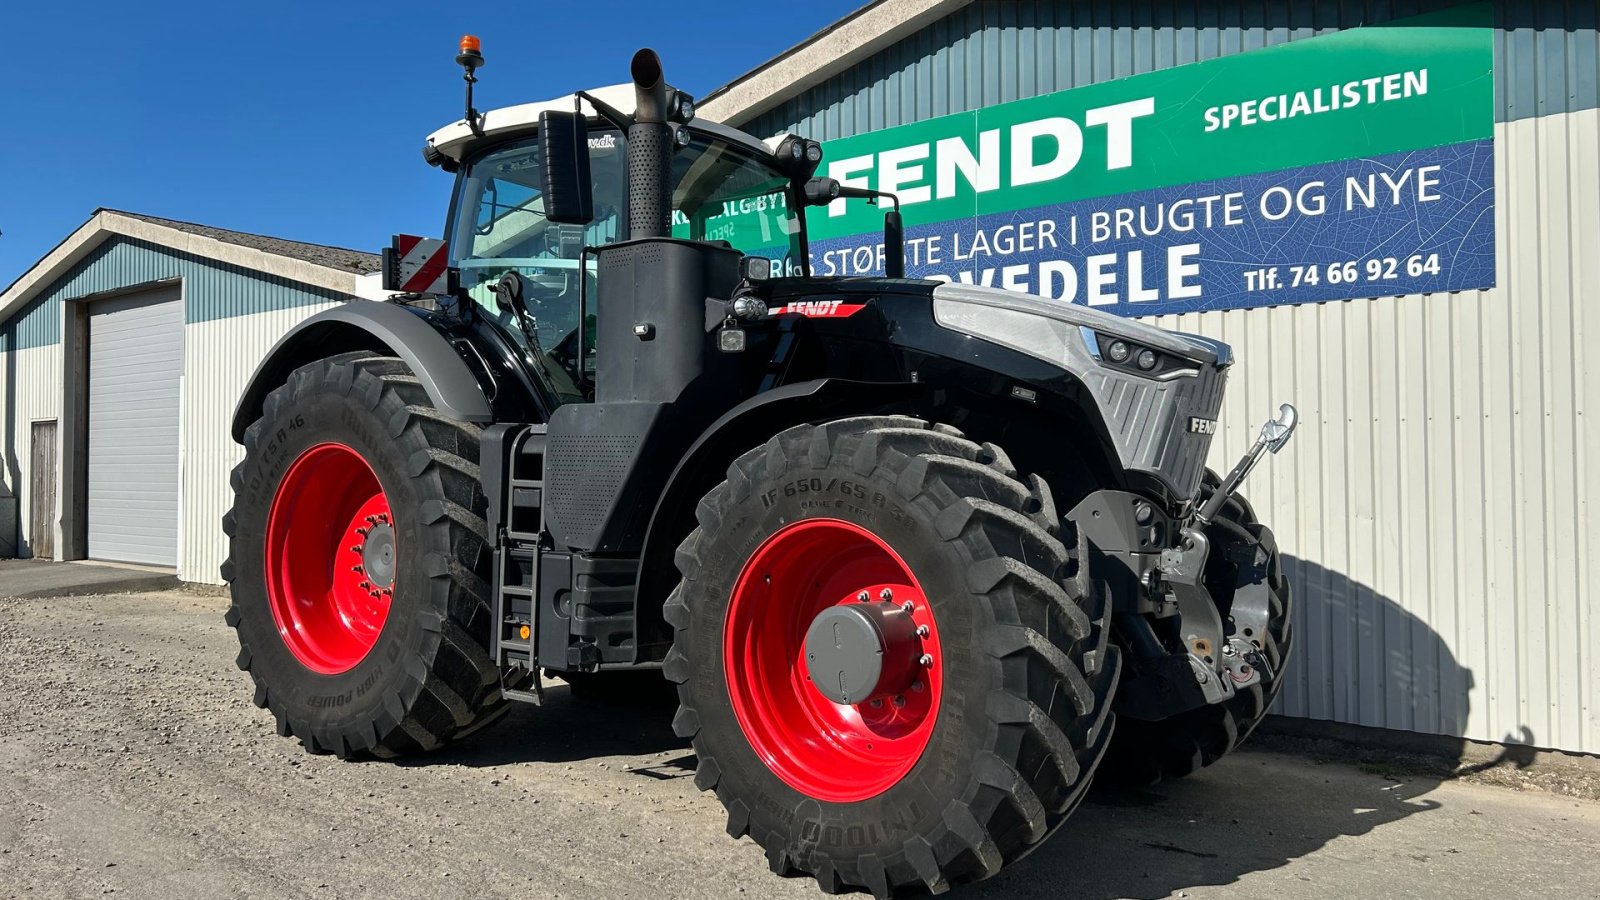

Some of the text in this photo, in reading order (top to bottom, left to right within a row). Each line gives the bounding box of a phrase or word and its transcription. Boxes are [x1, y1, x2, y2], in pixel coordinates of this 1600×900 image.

[828, 68, 1428, 218] FENDT SPECIALISTEN
[953, 219, 1057, 262] LAGER
[1070, 215, 1077, 246] I
[1091, 191, 1244, 243] BRUGTE
[1259, 181, 1325, 221] OG
[1345, 165, 1441, 211] NYE
[1244, 253, 1441, 292] Tlf. 74 66 92 64
[786, 300, 844, 316] FENDT
[760, 488, 777, 509] IF
[783, 477, 867, 499] 650/65
